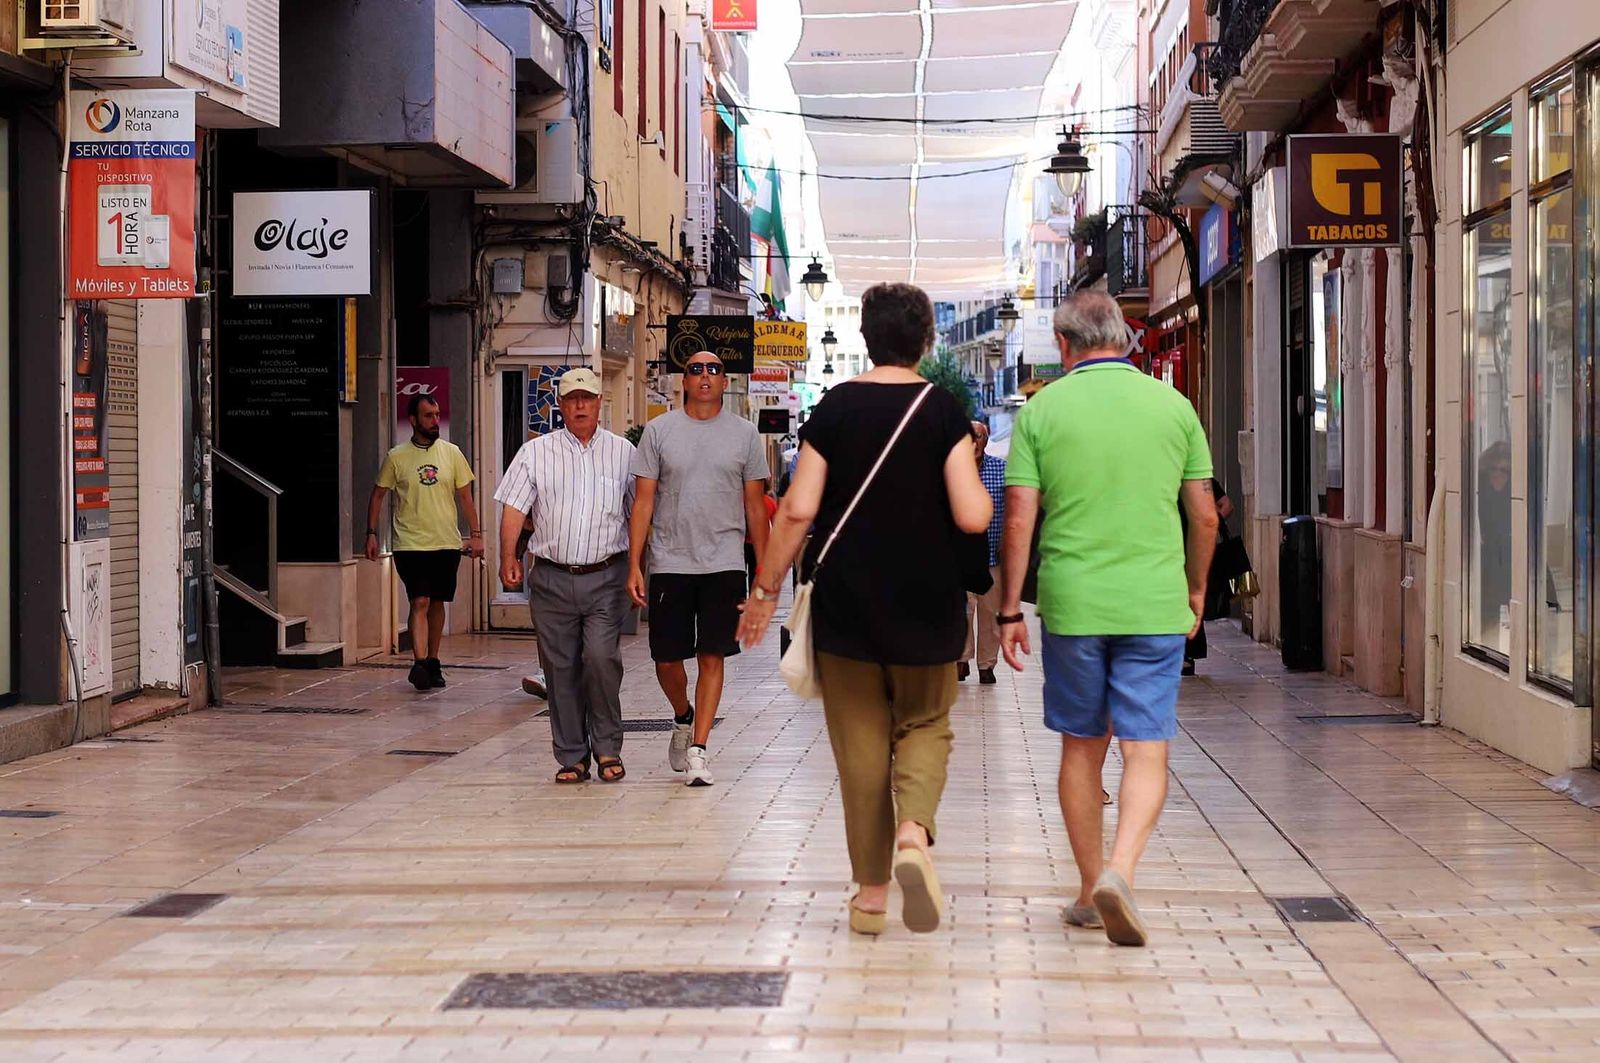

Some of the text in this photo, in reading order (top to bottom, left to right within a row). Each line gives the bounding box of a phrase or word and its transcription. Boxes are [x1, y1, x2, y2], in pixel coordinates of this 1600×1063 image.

[125, 107, 179, 118] Manzana
[125, 120, 152, 131] Rota
[76, 142, 190, 156] SERVICIO TÉCNICO
[97, 163, 109, 171] TU
[97, 174, 153, 182] DISPOSITIVO
[101, 198, 147, 208] LISTO EN
[108, 212, 138, 255] 1 HORA
[253, 218, 349, 258] Olaje
[1307, 224, 1388, 240] TABACOS
[75, 277, 190, 296] Móviles y Tablets
[715, 346, 743, 361] Taller
